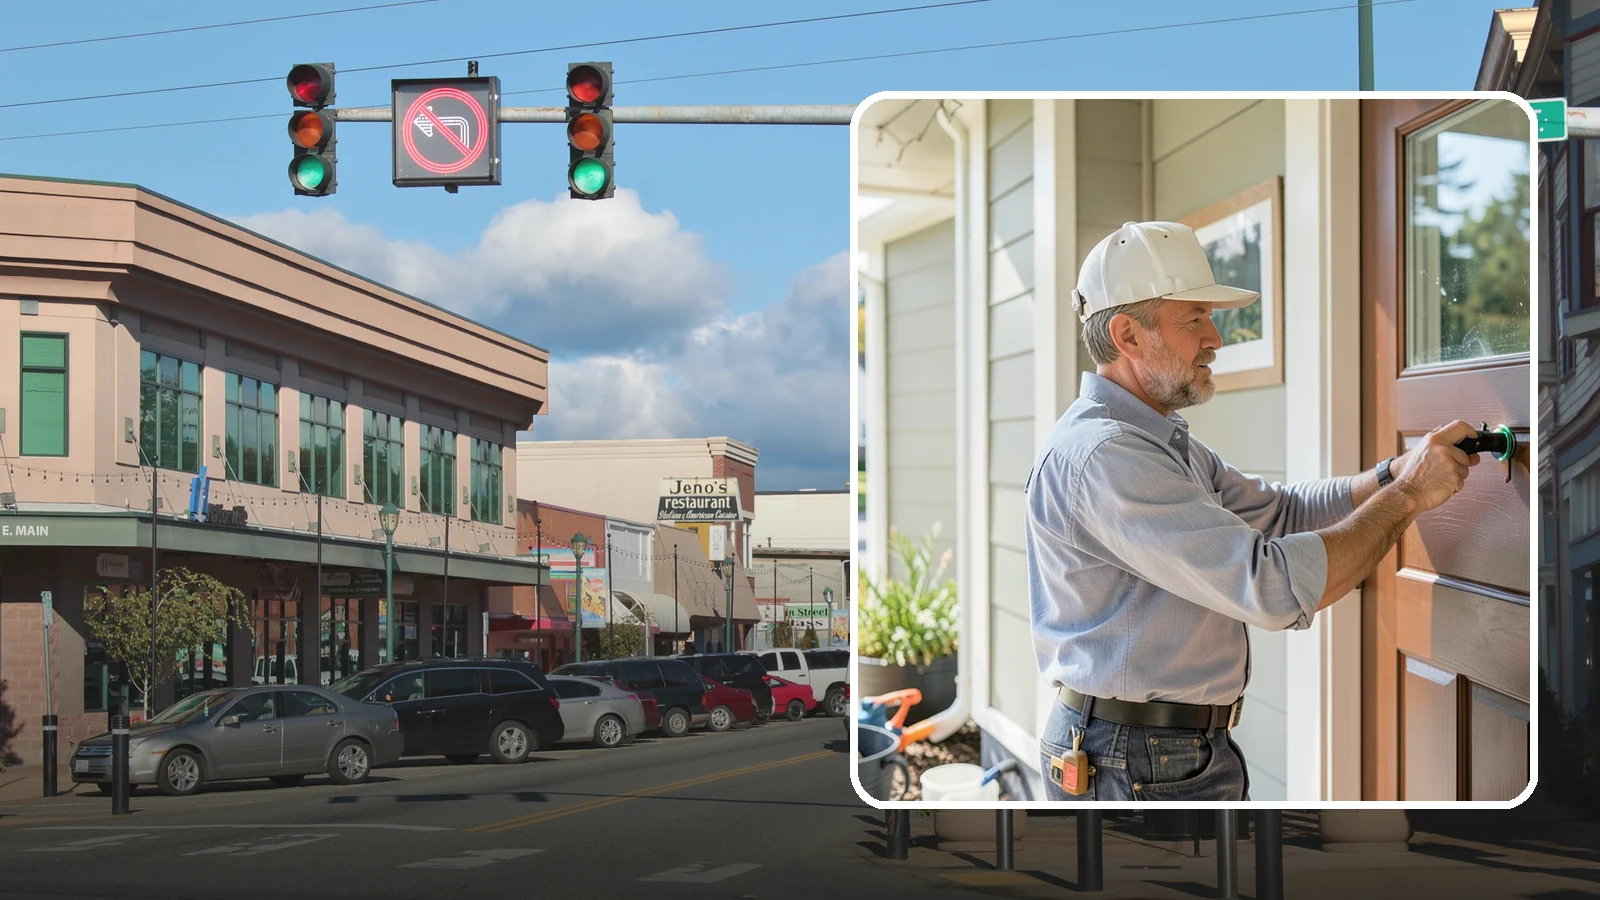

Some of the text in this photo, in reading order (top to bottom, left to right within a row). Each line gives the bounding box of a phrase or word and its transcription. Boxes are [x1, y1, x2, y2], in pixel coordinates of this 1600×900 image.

[669, 480, 728, 495] Jeno's
[665, 496, 731, 509] restaurant
[658, 510, 682, 520] Italian
[686, 509, 715, 519] American
[715, 509, 738, 520] Cuisine
[2, 525, 49, 537] E. MAIN
[797, 607, 829, 617] Street
[790, 619, 824, 627] lass
